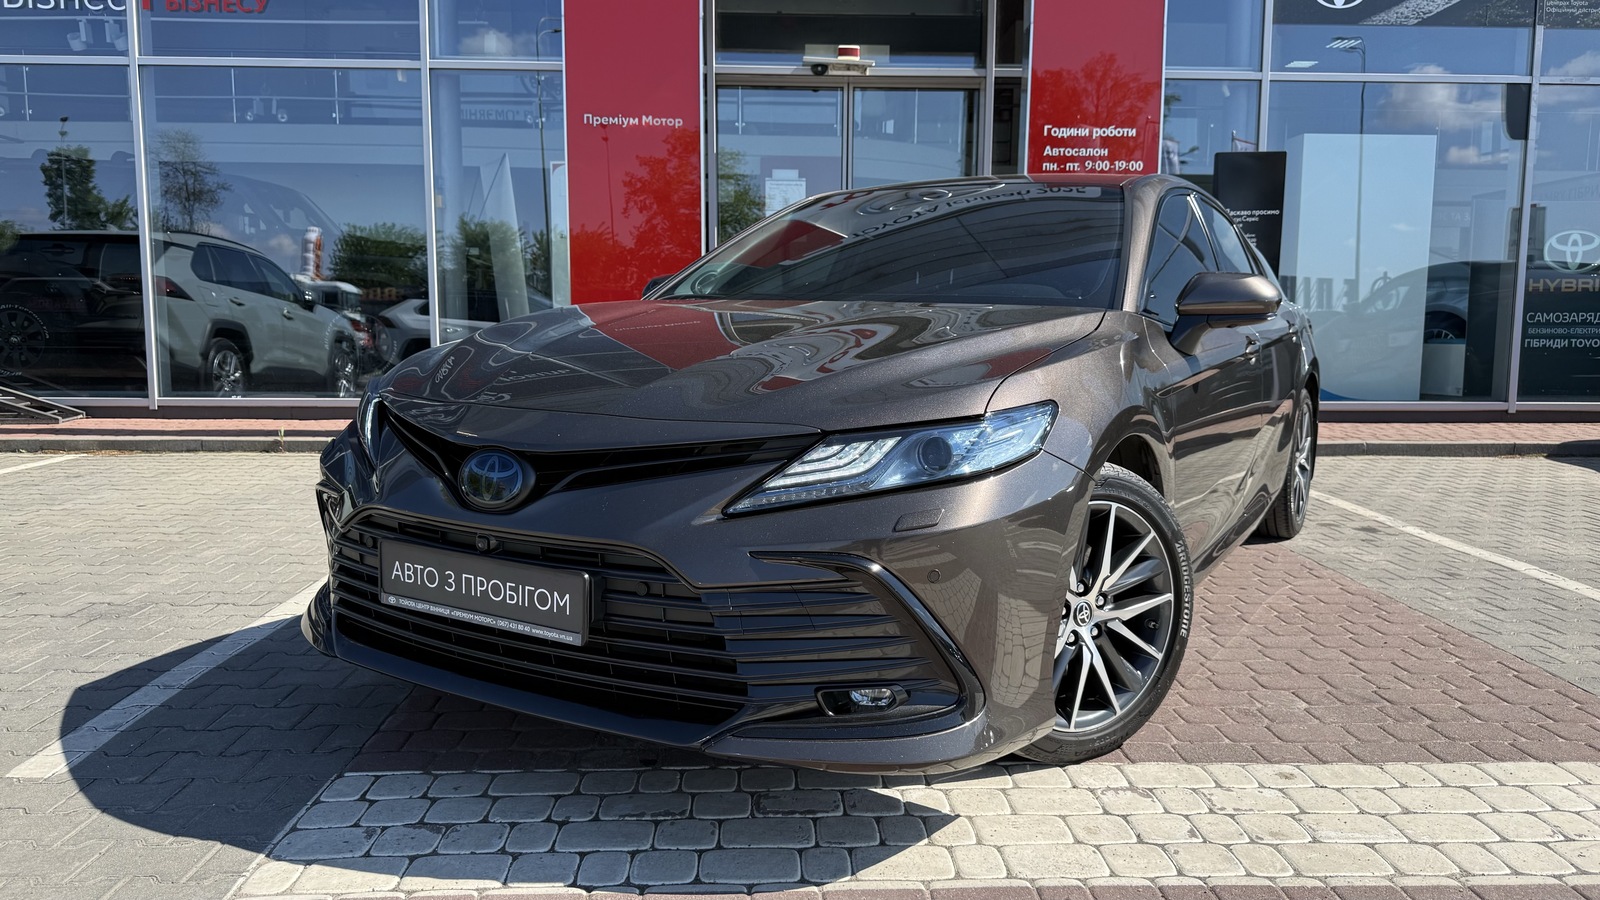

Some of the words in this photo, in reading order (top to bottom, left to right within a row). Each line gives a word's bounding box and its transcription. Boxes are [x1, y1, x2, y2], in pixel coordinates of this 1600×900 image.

[583, 113, 638, 128] Преміум
[642, 114, 683, 128] Мотор
[1043, 124, 1089, 138] Години
[1092, 125, 1136, 139] роботи
[1043, 145, 1108, 156] Автосалон
[1085, 160, 1144, 171] 9:00-19:00
[1524, 338, 1568, 349] ГІБРИДИ
[391, 560, 439, 588] АВТО
[444, 570, 456, 592] З
[462, 573, 570, 616] ПРОБІГОМ
[1175, 540, 1191, 638] BRIDGESTONE
[399, 598, 416, 607] ТОЙОТА
[416, 602, 430, 610] ЦЕНТР
[430, 605, 450, 615] ВІННИЦЯ
[497, 619, 510, 628] (067)
[509, 622, 518, 630] 431
[531, 628, 573, 641] www.toyota.vn.ua
